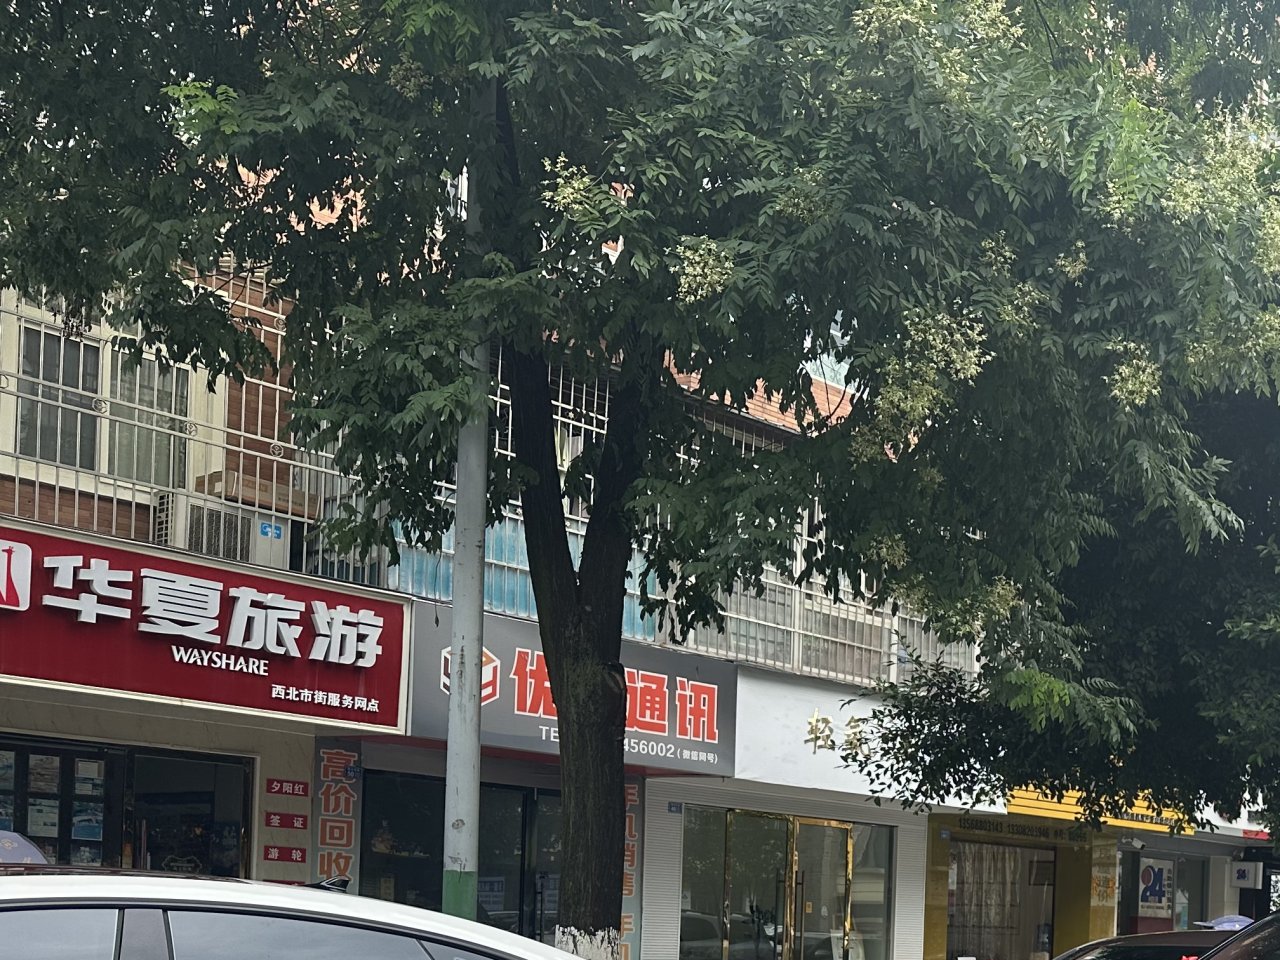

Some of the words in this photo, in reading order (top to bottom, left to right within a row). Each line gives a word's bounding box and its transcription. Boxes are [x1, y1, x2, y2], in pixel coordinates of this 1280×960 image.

[42, 555, 384, 668] 华夏旅游
[171, 645, 269, 676] WAYSHARE
[271, 684, 380, 713] 西北市街服务网点
[510, 647, 719, 744] 优通讯
[539, 725, 559, 742] TE
[623, 738, 675, 758] 456002
[271, 781, 305, 795] 夕阳红
[318, 749, 358, 881] 高价回收
[1141, 864, 1166, 904] 24
